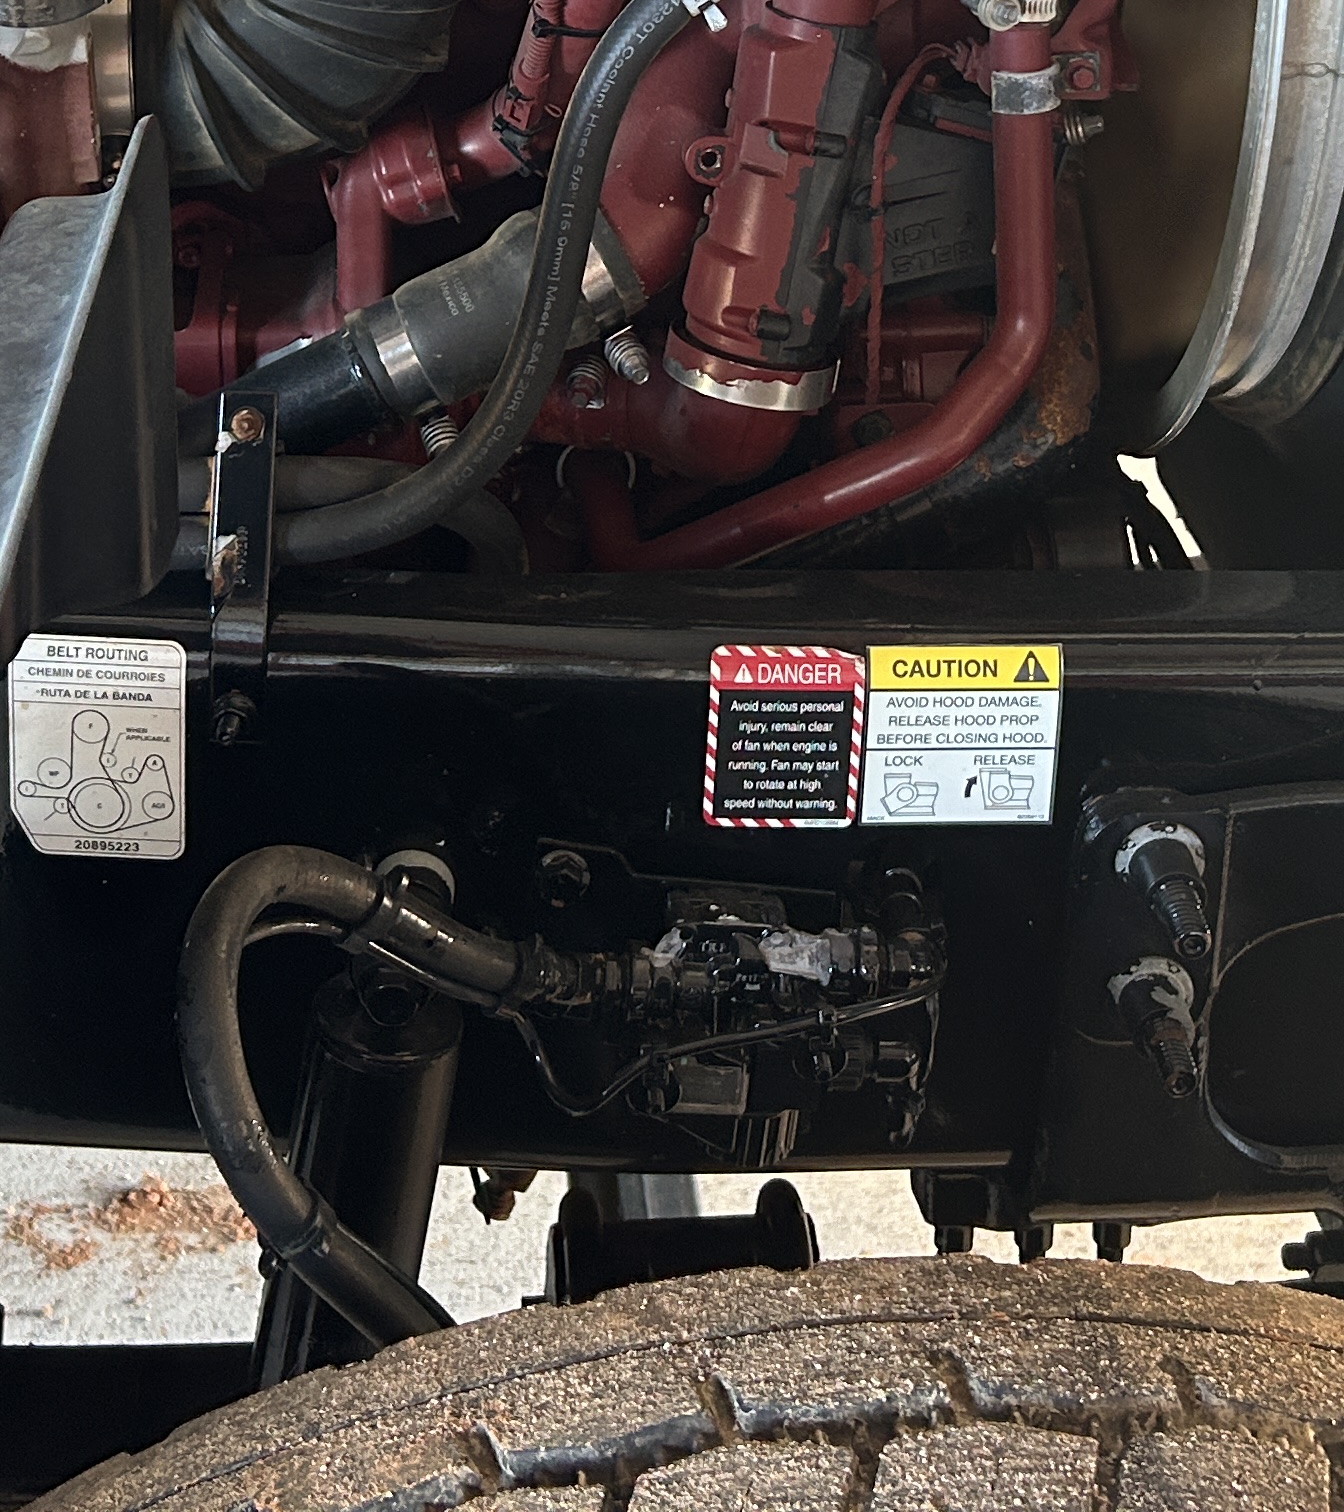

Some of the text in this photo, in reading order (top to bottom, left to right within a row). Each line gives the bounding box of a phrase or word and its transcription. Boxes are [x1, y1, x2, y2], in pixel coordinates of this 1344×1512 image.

[595, 46, 635, 108] Coolant
[576, 113, 599, 158] Hose
[538, 286, 558, 334] Meets
[522, 340, 544, 376] SAE
[47, 646, 149, 661] BELT ROUTING
[28, 667, 165, 682] CHEMIN DE COURROIES
[758, 663, 841, 685] DANGER
[893, 660, 998, 679] CAUTION
[40, 689, 153, 702] RUTA DE LA BANDA
[886, 696, 1042, 708] AVOID HOOD DAMAGE.
[731, 700, 844, 715] Avoid serious personal
[739, 720, 833, 734] injury, remain clear
[889, 715, 1039, 726] RELEASE HOOD PROP
[877, 733, 1047, 745] BEFORE CLOSING HOOD.
[732, 740, 837, 754] of fan when engine is
[728, 760, 839, 774] running. Fan may start
[885, 755, 923, 767] LOCK
[974, 755, 1035, 766] RELEASE
[744, 779, 821, 793] to rotate at high
[724, 798, 837, 812] speed without warning.
[75, 840, 139, 852] 20895223
